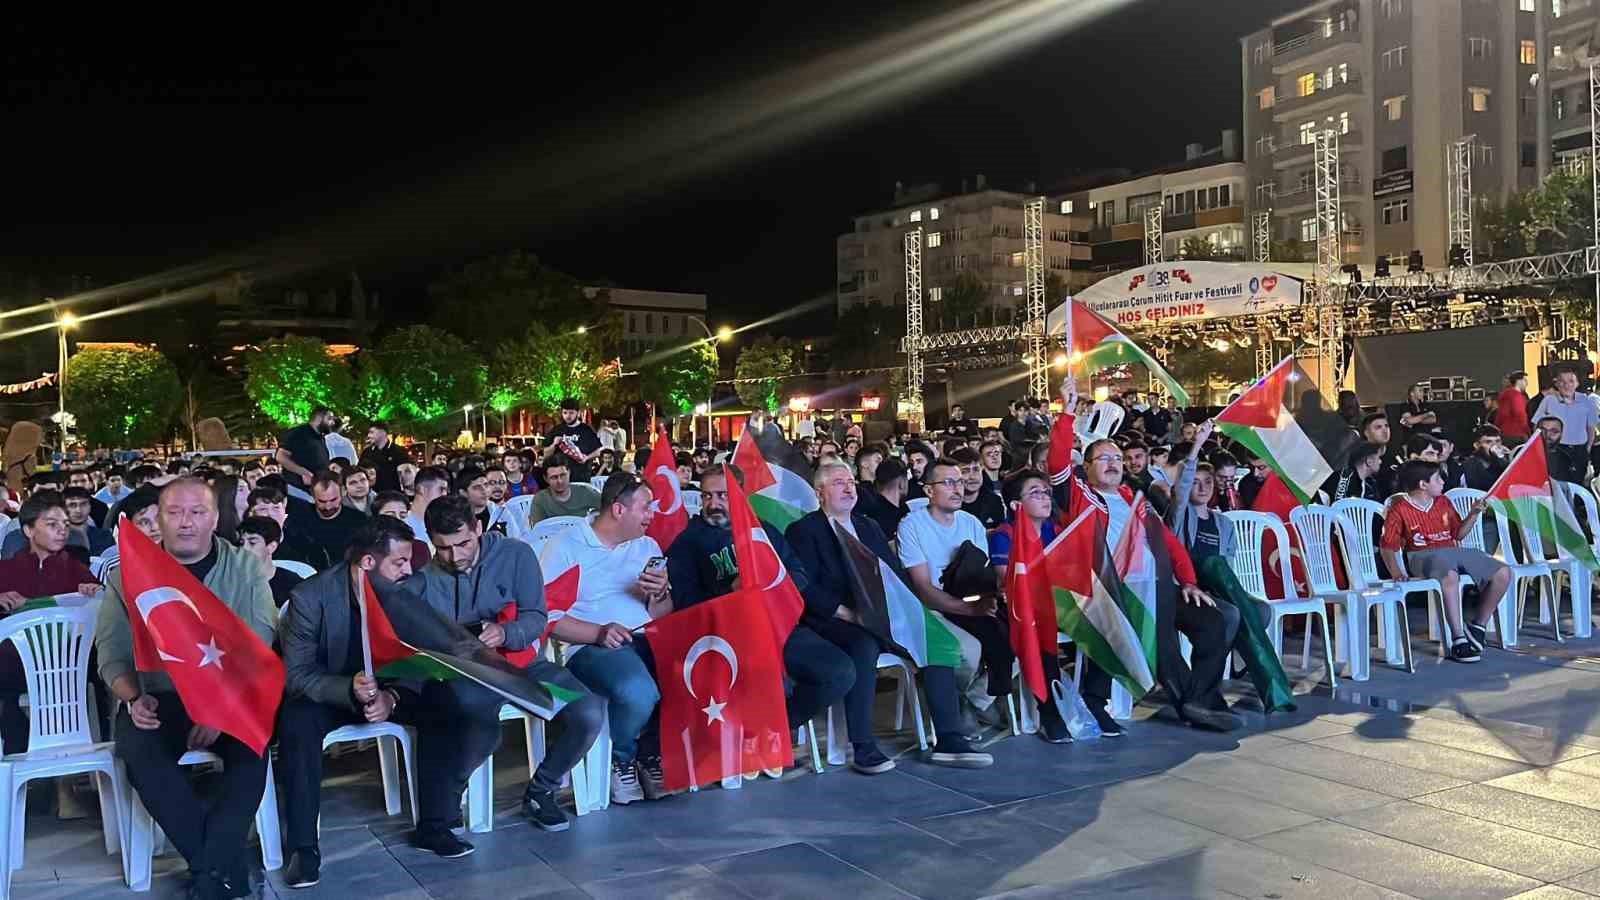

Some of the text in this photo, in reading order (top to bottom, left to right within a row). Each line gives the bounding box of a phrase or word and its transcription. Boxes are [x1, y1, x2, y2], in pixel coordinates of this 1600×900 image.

[1155, 292, 1173, 303] Hitit
[1175, 291, 1192, 302] Fuar
[1194, 290, 1204, 299] ve
[1205, 283, 1242, 297] Festivali
